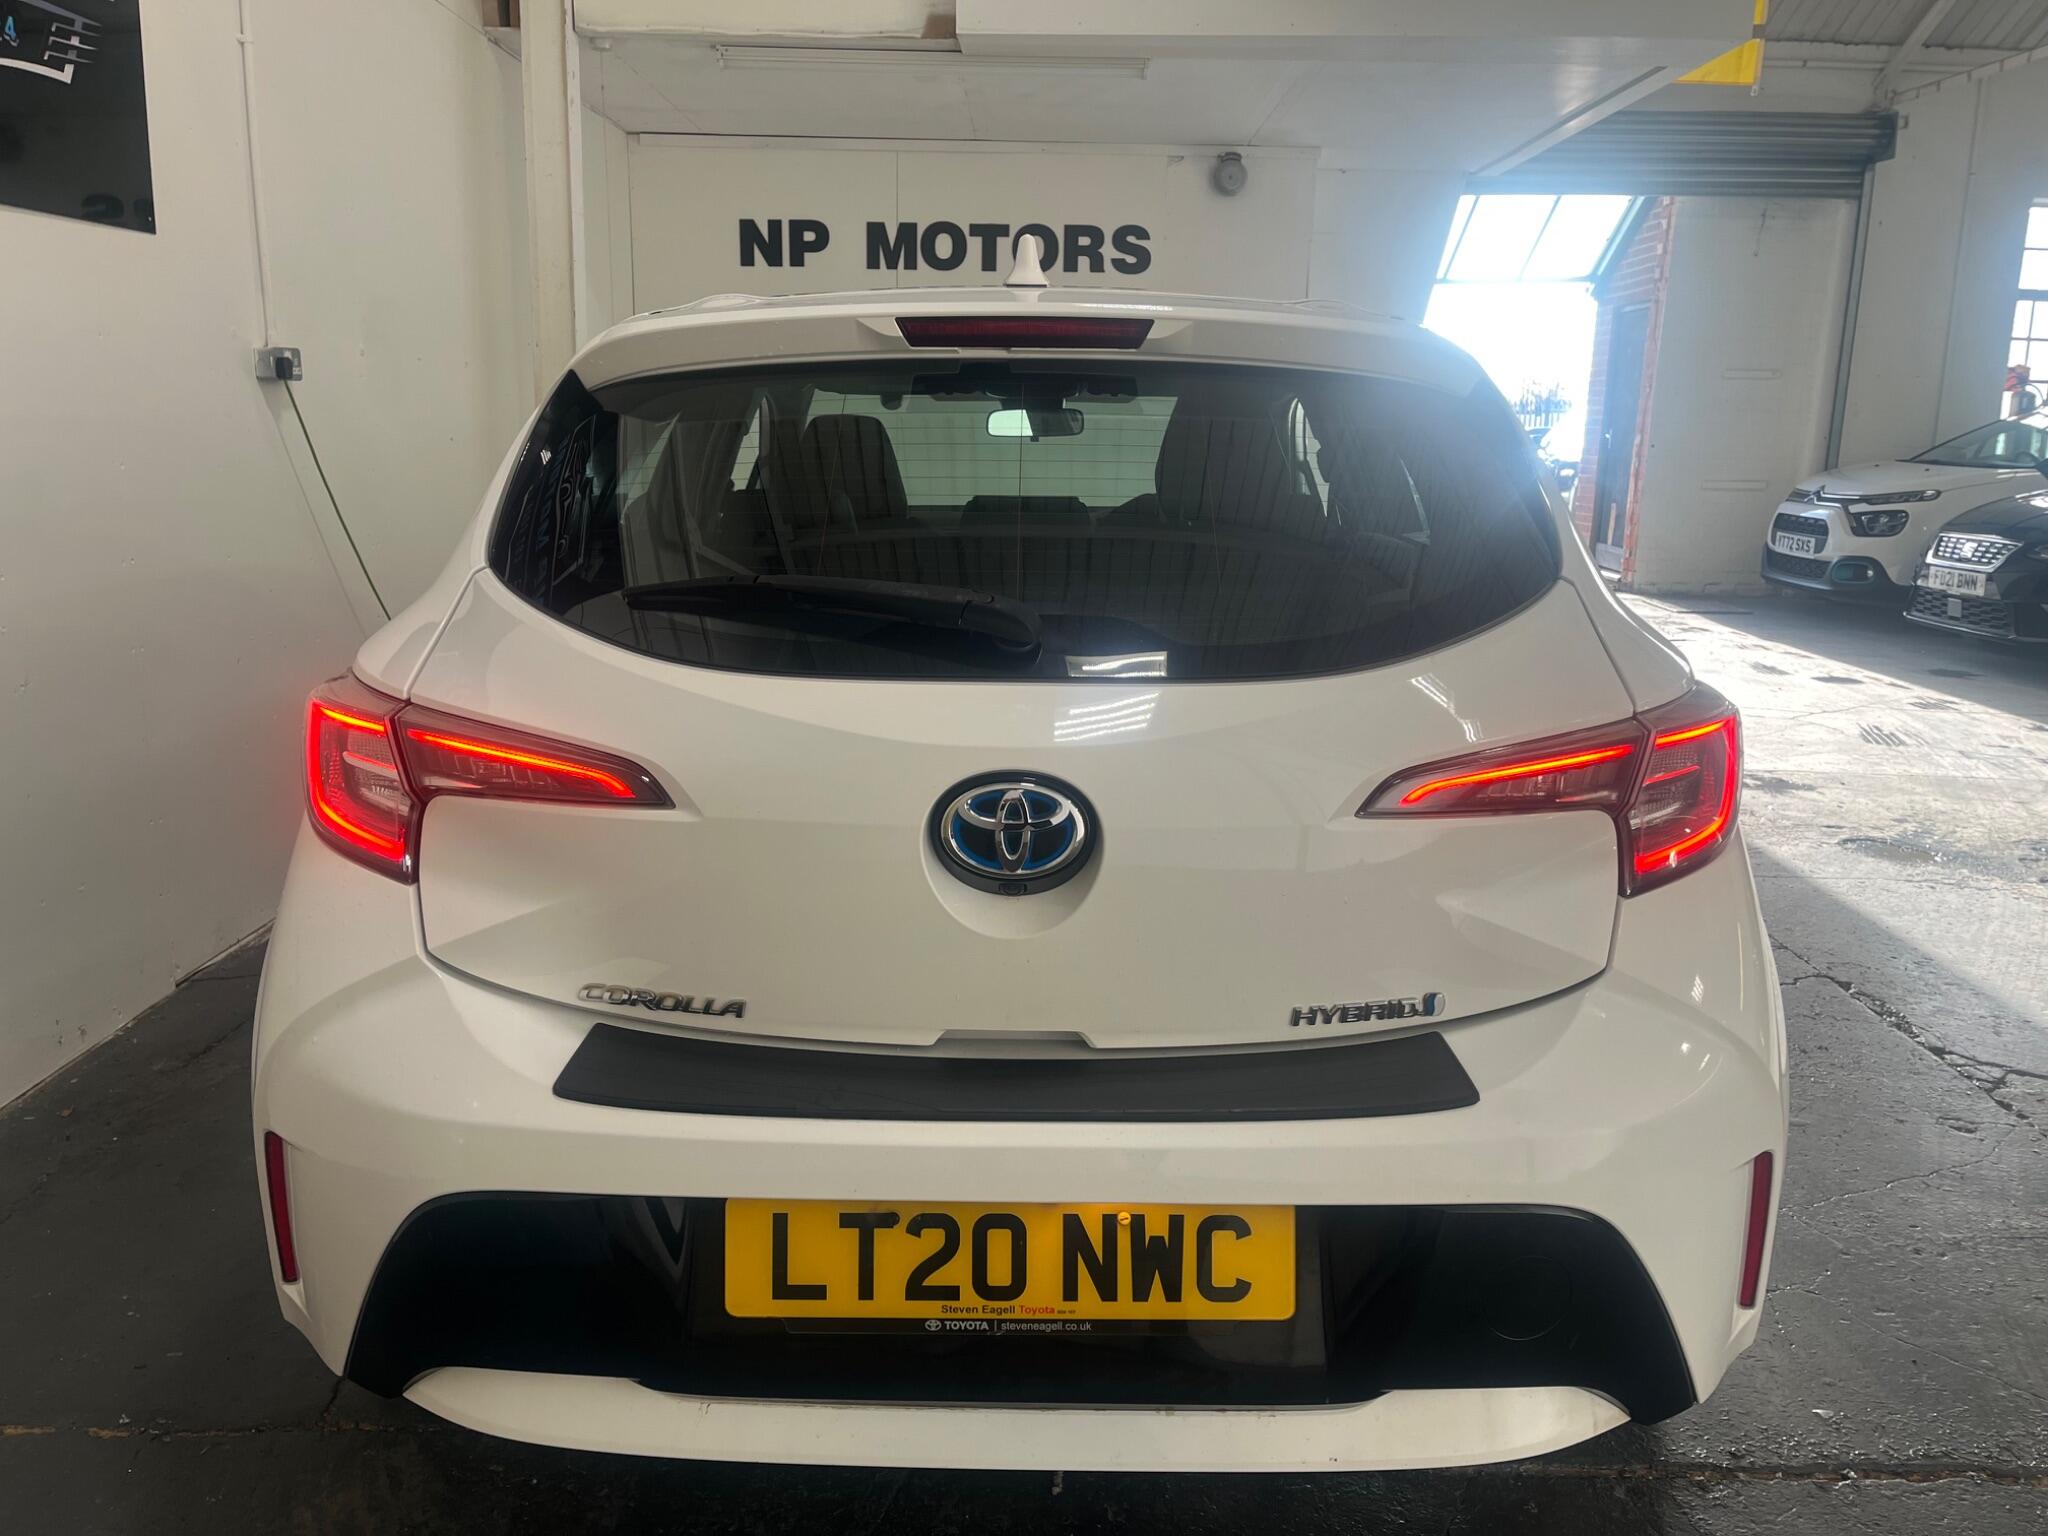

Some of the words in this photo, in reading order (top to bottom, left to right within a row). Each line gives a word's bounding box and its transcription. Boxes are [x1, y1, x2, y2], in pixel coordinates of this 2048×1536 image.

[739, 218, 830, 267] NP
[866, 221, 1152, 275] MOTORS
[1778, 535, 1795, 551] YT72
[1795, 537, 1811, 553] SXS
[1956, 572, 1978, 591] BNN
[577, 982, 747, 1018] COROLLA
[1290, 997, 1421, 1027] HYBRID
[771, 1211, 1028, 1302] LT20
[1062, 1212, 1253, 1303] NWC
[941, 1304, 979, 1315] Steven
[981, 1304, 1016, 1317] Eagell
[1018, 1304, 1056, 1317] Toyota
[944, 1320, 990, 1332] TOYOTA
[1001, 1320, 1092, 1333] steveneagell.co.uk
